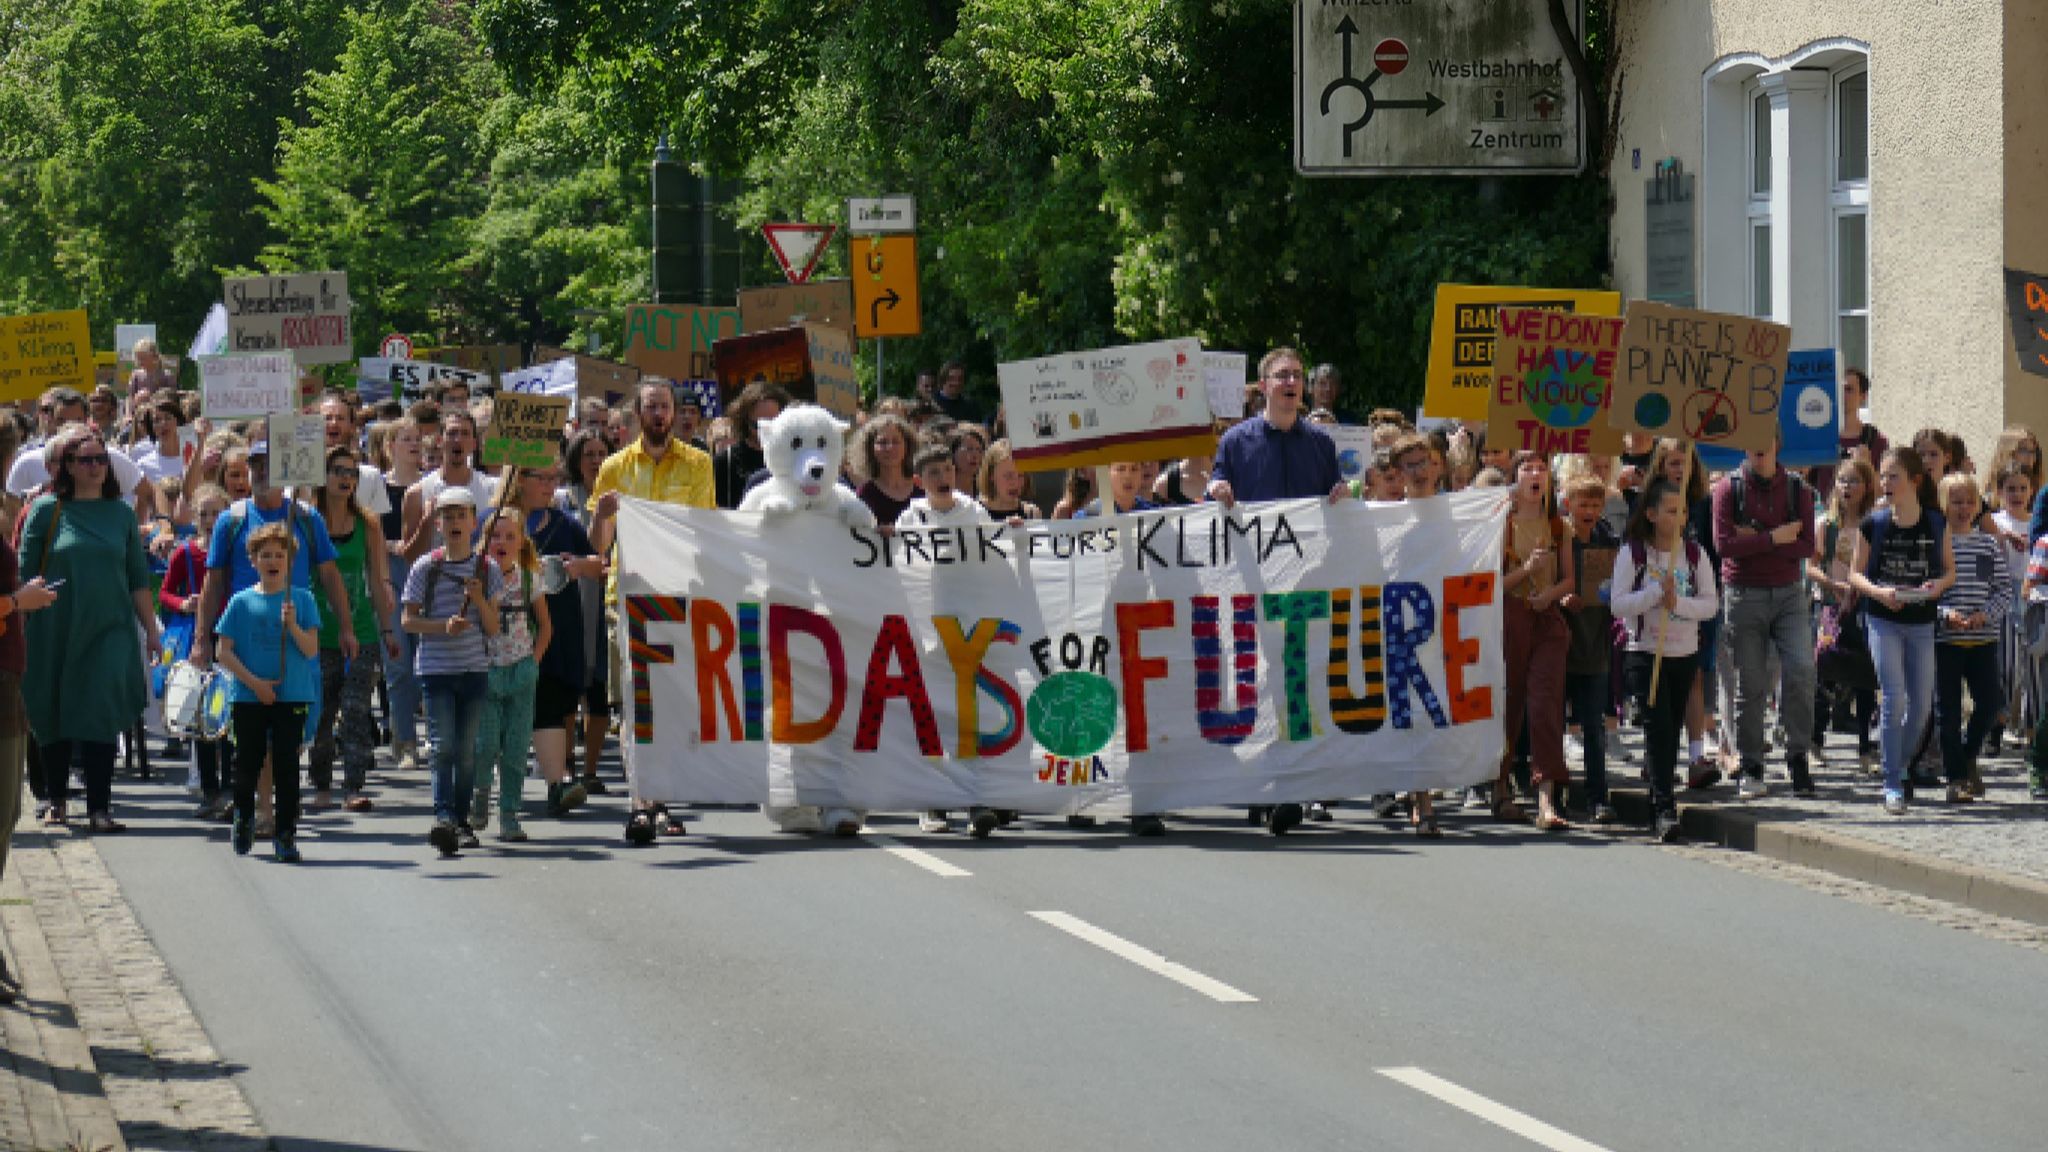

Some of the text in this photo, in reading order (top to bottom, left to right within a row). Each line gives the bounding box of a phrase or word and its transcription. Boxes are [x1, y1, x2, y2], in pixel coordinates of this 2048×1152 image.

[1428, 59, 1562, 78] Westbahnhof
[1470, 130, 1562, 148] Zentrum
[625, 307, 686, 352] ACT
[1499, 308, 1625, 349] WE DON'T
[1642, 315, 1780, 360] THERE IS NO
[391, 362, 420, 385] ES
[1517, 344, 1617, 379] HAVE
[1628, 346, 1780, 415] PLANET B
[1516, 420, 1591, 454] TIME
[1137, 514, 1304, 571] KLIMA
[625, 572, 1496, 760] FRIDAYS FOR FUTURE
[1038, 755, 1110, 786] JENA
